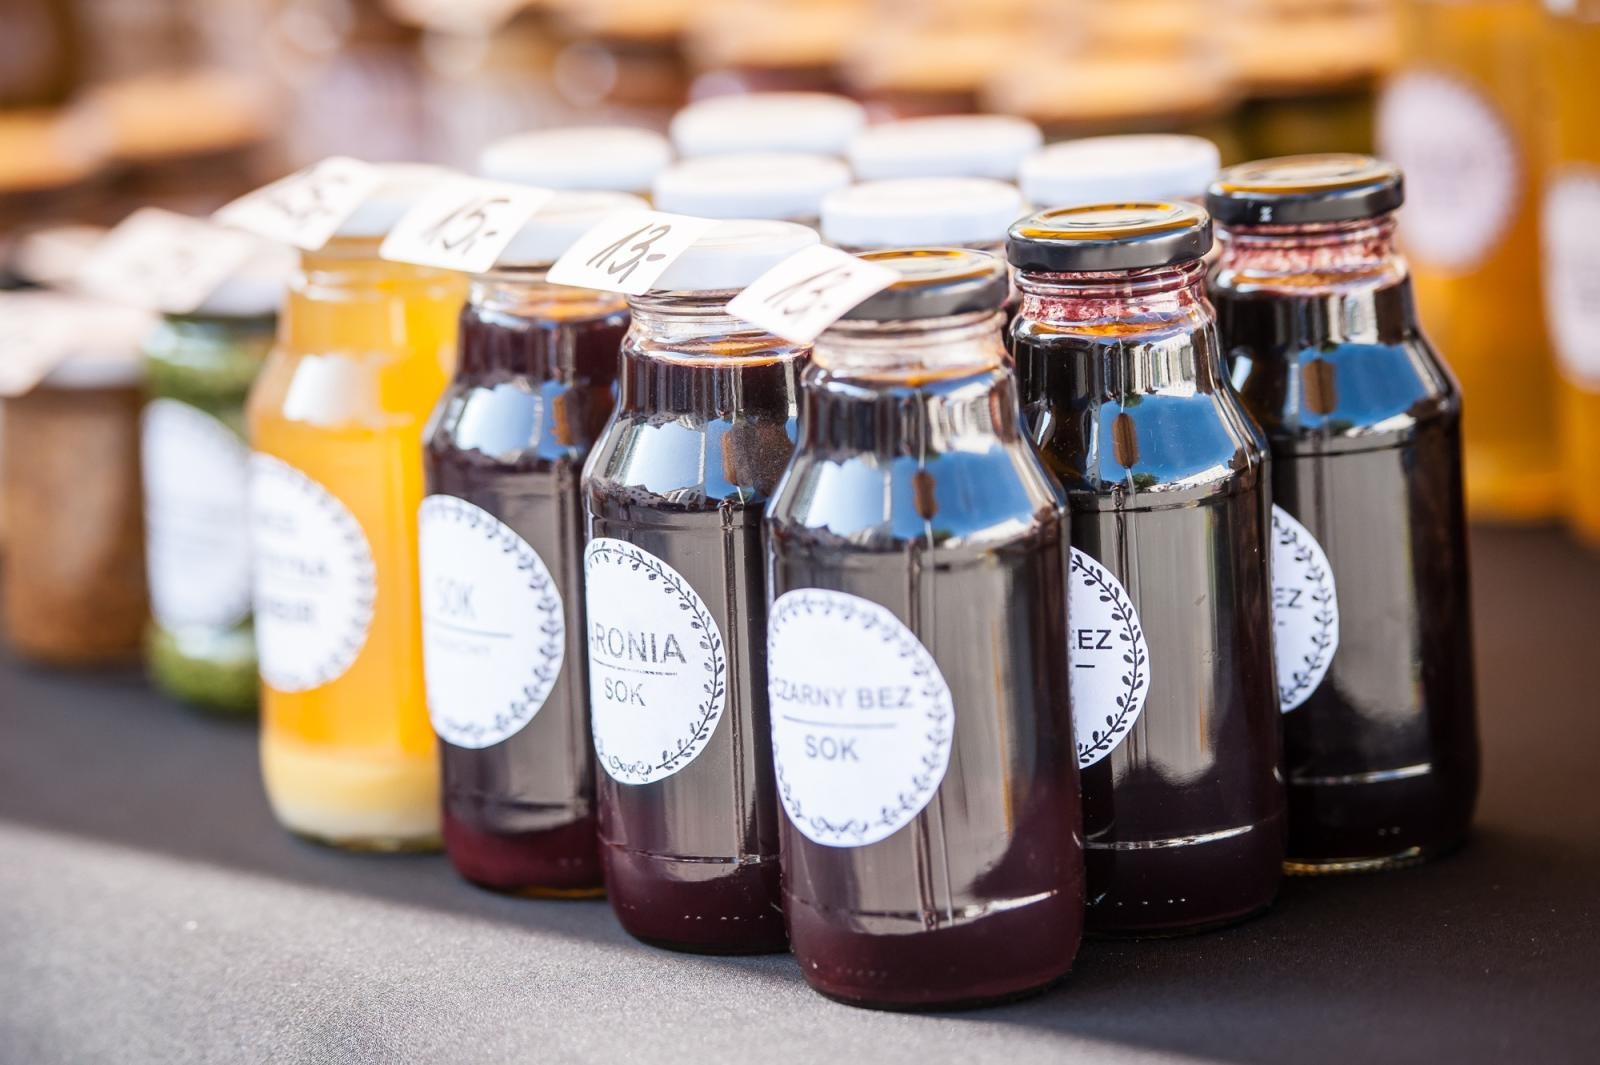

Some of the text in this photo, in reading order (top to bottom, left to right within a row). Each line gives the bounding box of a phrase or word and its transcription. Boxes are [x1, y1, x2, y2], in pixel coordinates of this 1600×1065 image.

[604, 677, 647, 707] SOK
[772, 677, 914, 710] CZARNY BEZ
[805, 733, 861, 763] SOK
